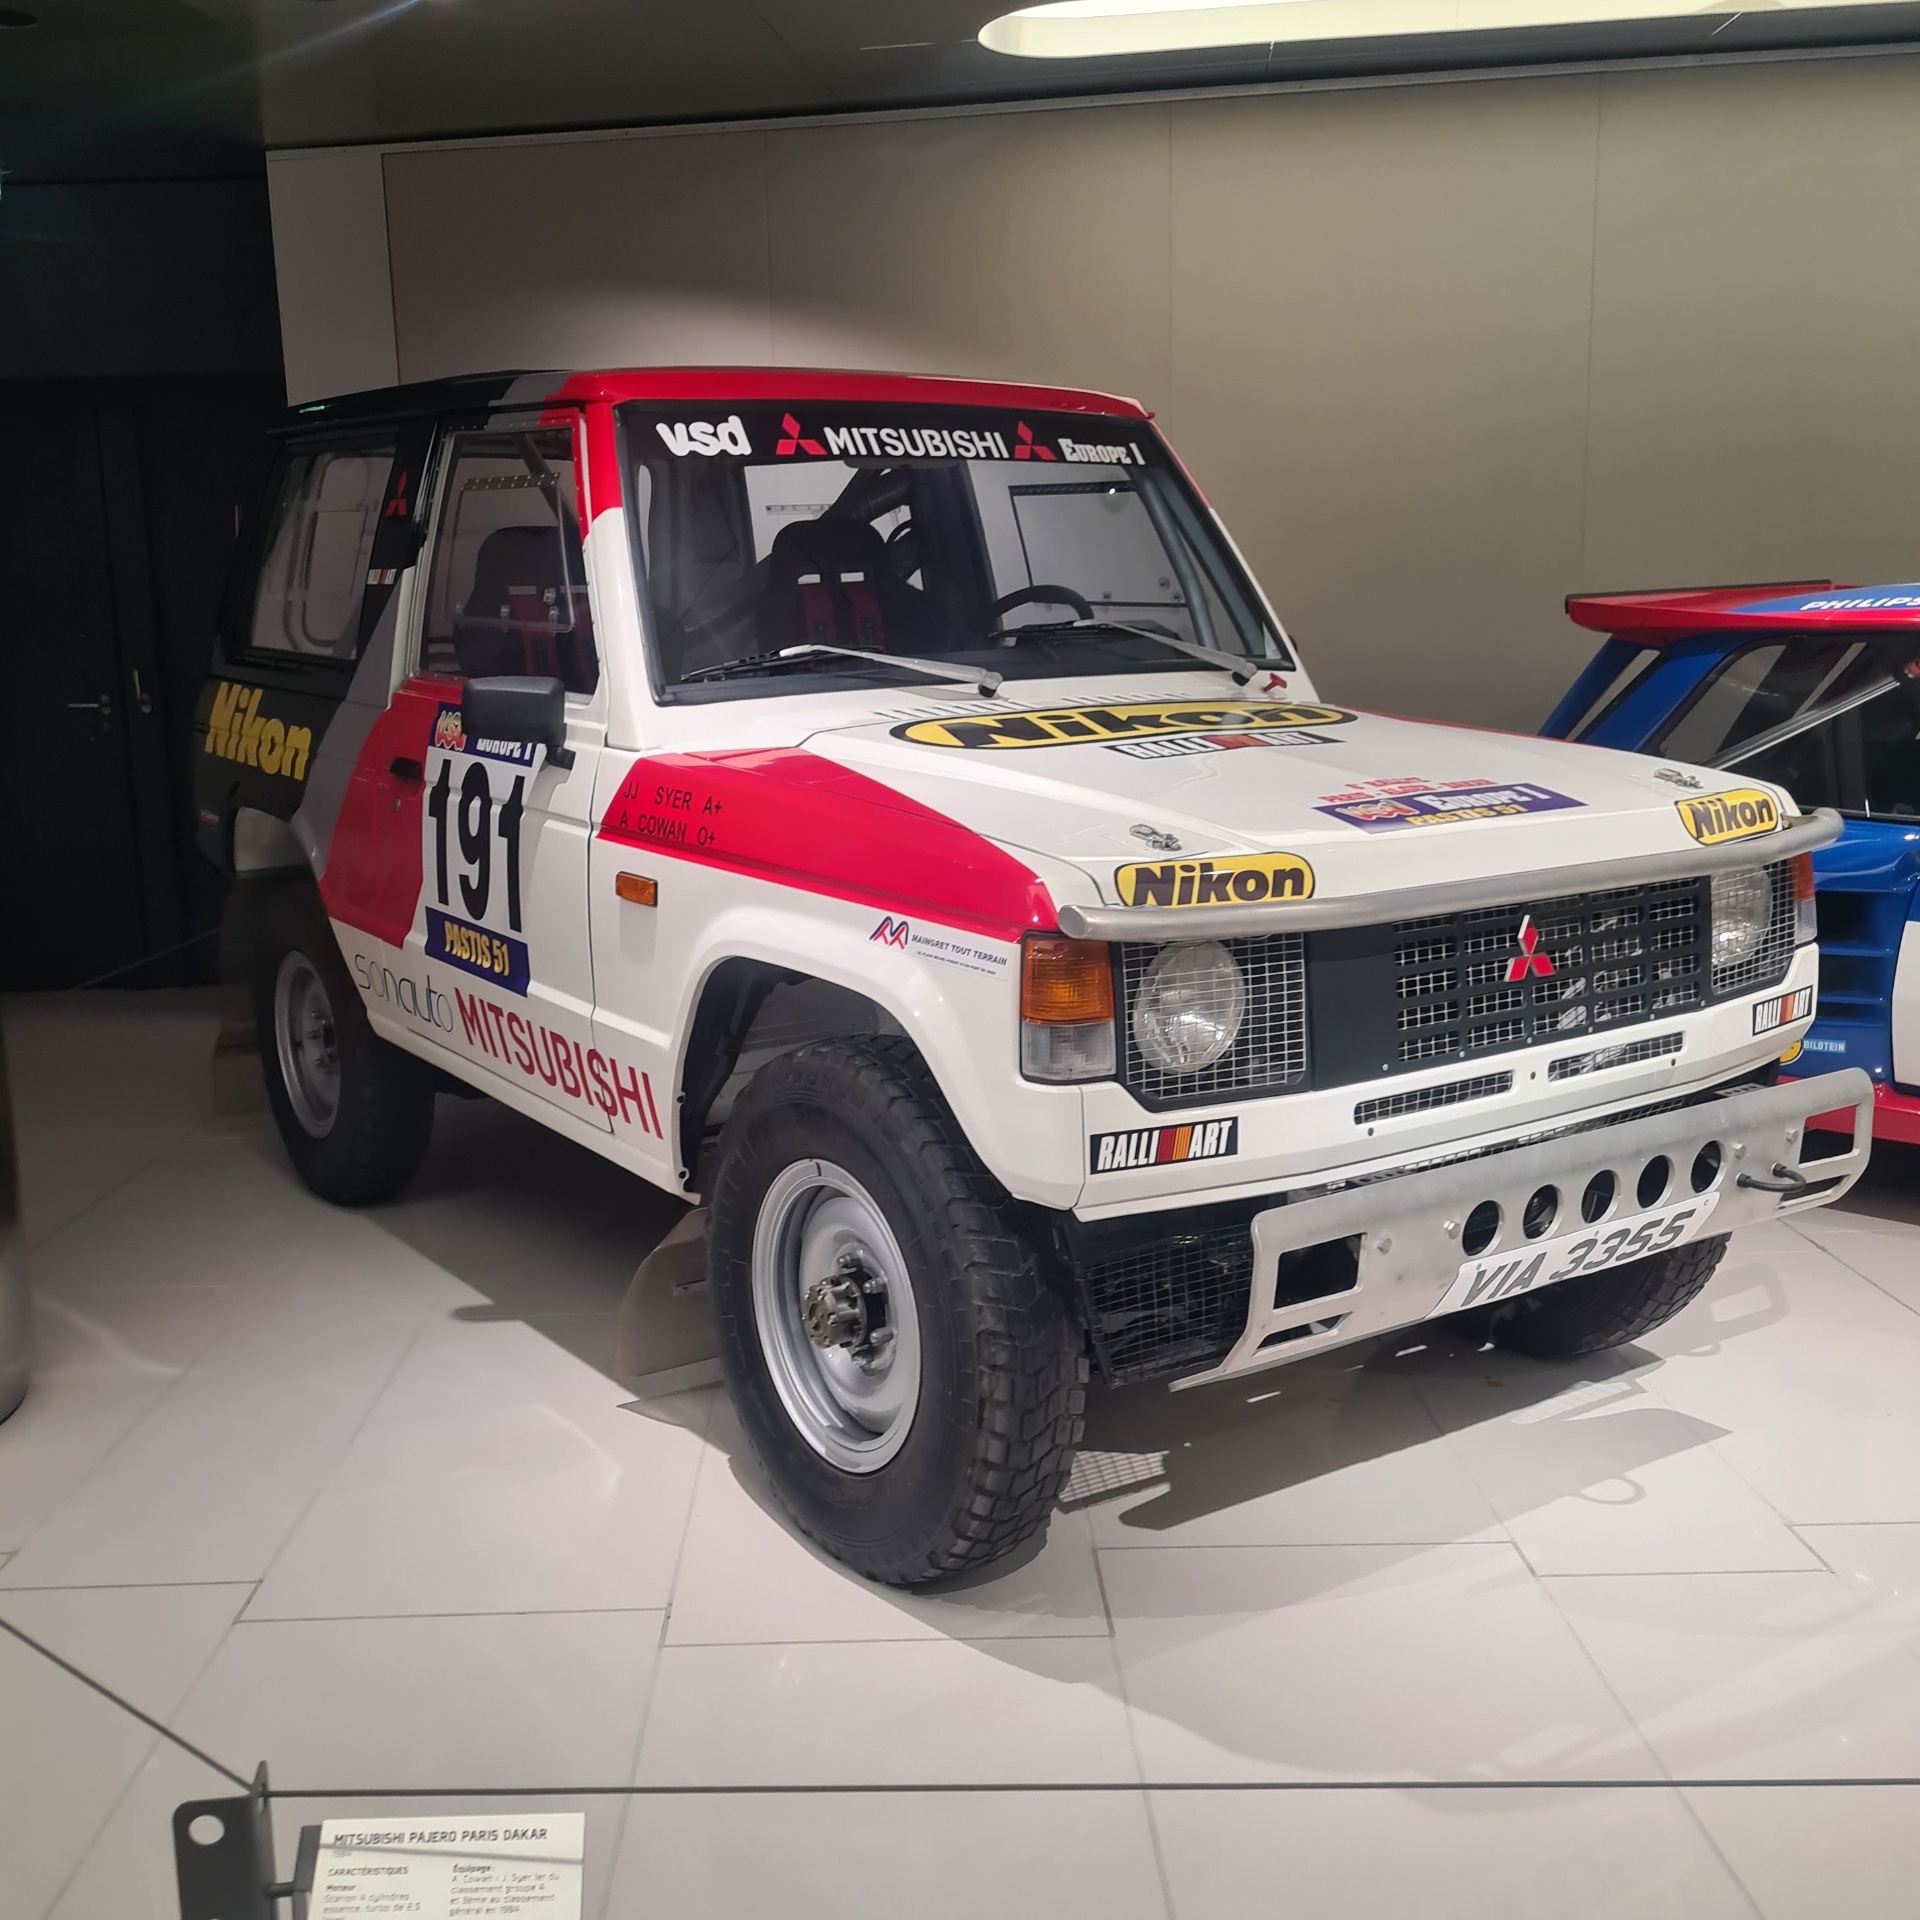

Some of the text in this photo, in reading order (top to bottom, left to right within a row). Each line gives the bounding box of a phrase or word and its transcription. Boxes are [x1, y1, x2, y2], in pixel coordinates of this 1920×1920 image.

[824, 426, 1009, 459] MITSUBISHI
[204, 682, 312, 781] Nikon
[937, 706, 1337, 748] Nikon
[623, 781, 722, 816] JJ SYER A+
[1404, 806, 1496, 827] PASTIS
[1691, 798, 1774, 839] Nikon
[428, 758, 526, 933] 191
[619, 813, 628, 829] A
[638, 815, 688, 842] COWAN
[1132, 862, 1305, 907] Nikon
[444, 920, 509, 977] PASTIS 51
[911, 933, 949, 950] MAINGRET
[951, 944, 972, 957] TOUT
[973, 950, 1009, 967] TERRAIN
[354, 953, 454, 1033] sonauto
[1754, 997, 1783, 1034] RALLI
[454, 987, 664, 1140] MITSUBISHI
[1803, 1040, 1846, 1052] BILSTEIN
[1096, 1120, 1233, 1171] RALLI ART
[1460, 1251, 1547, 1307] VIA
[333, 1828, 548, 1847] MITSUBISHI PAJERO PARIS DAKAR
